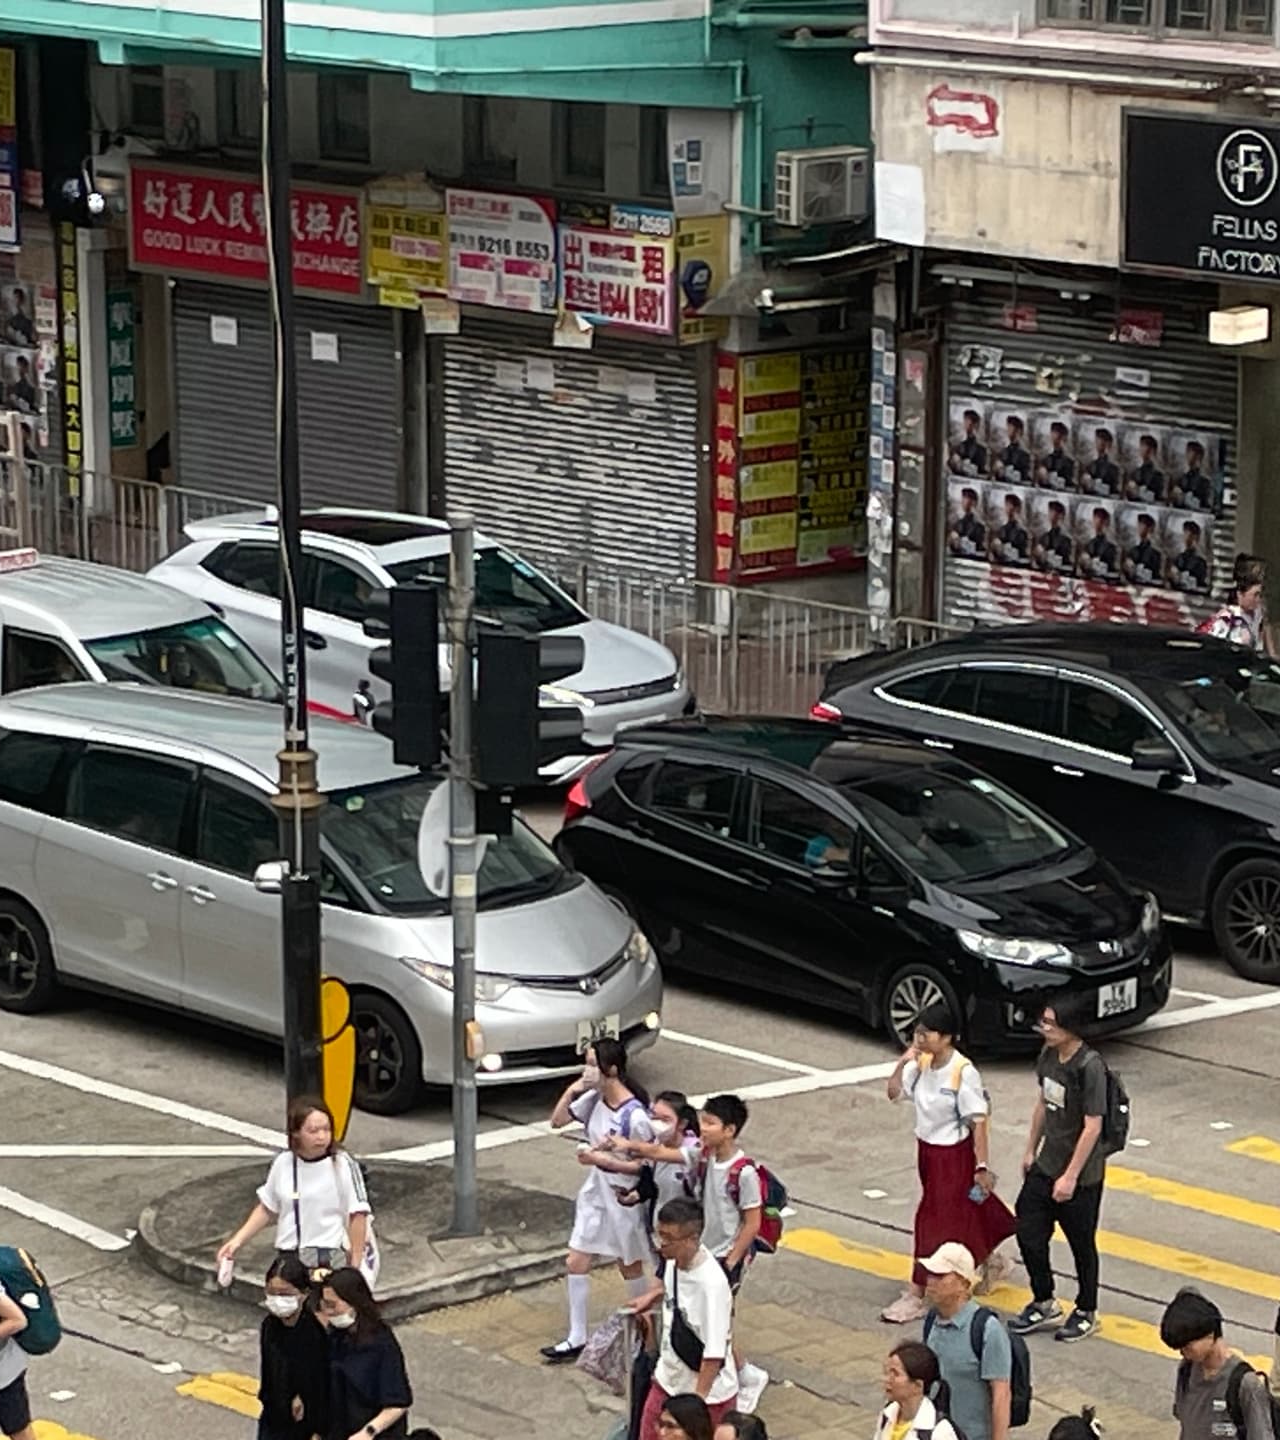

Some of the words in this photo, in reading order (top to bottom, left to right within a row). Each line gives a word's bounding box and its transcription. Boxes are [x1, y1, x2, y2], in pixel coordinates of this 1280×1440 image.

[1212, 214, 1278, 241] FELLAS
[143, 229, 183, 250] GOOD
[186, 235, 221, 256] LUCK
[293, 251, 360, 277] XCHANGE
[564, 233, 583, 272] 出
[642, 246, 665, 284] 租
